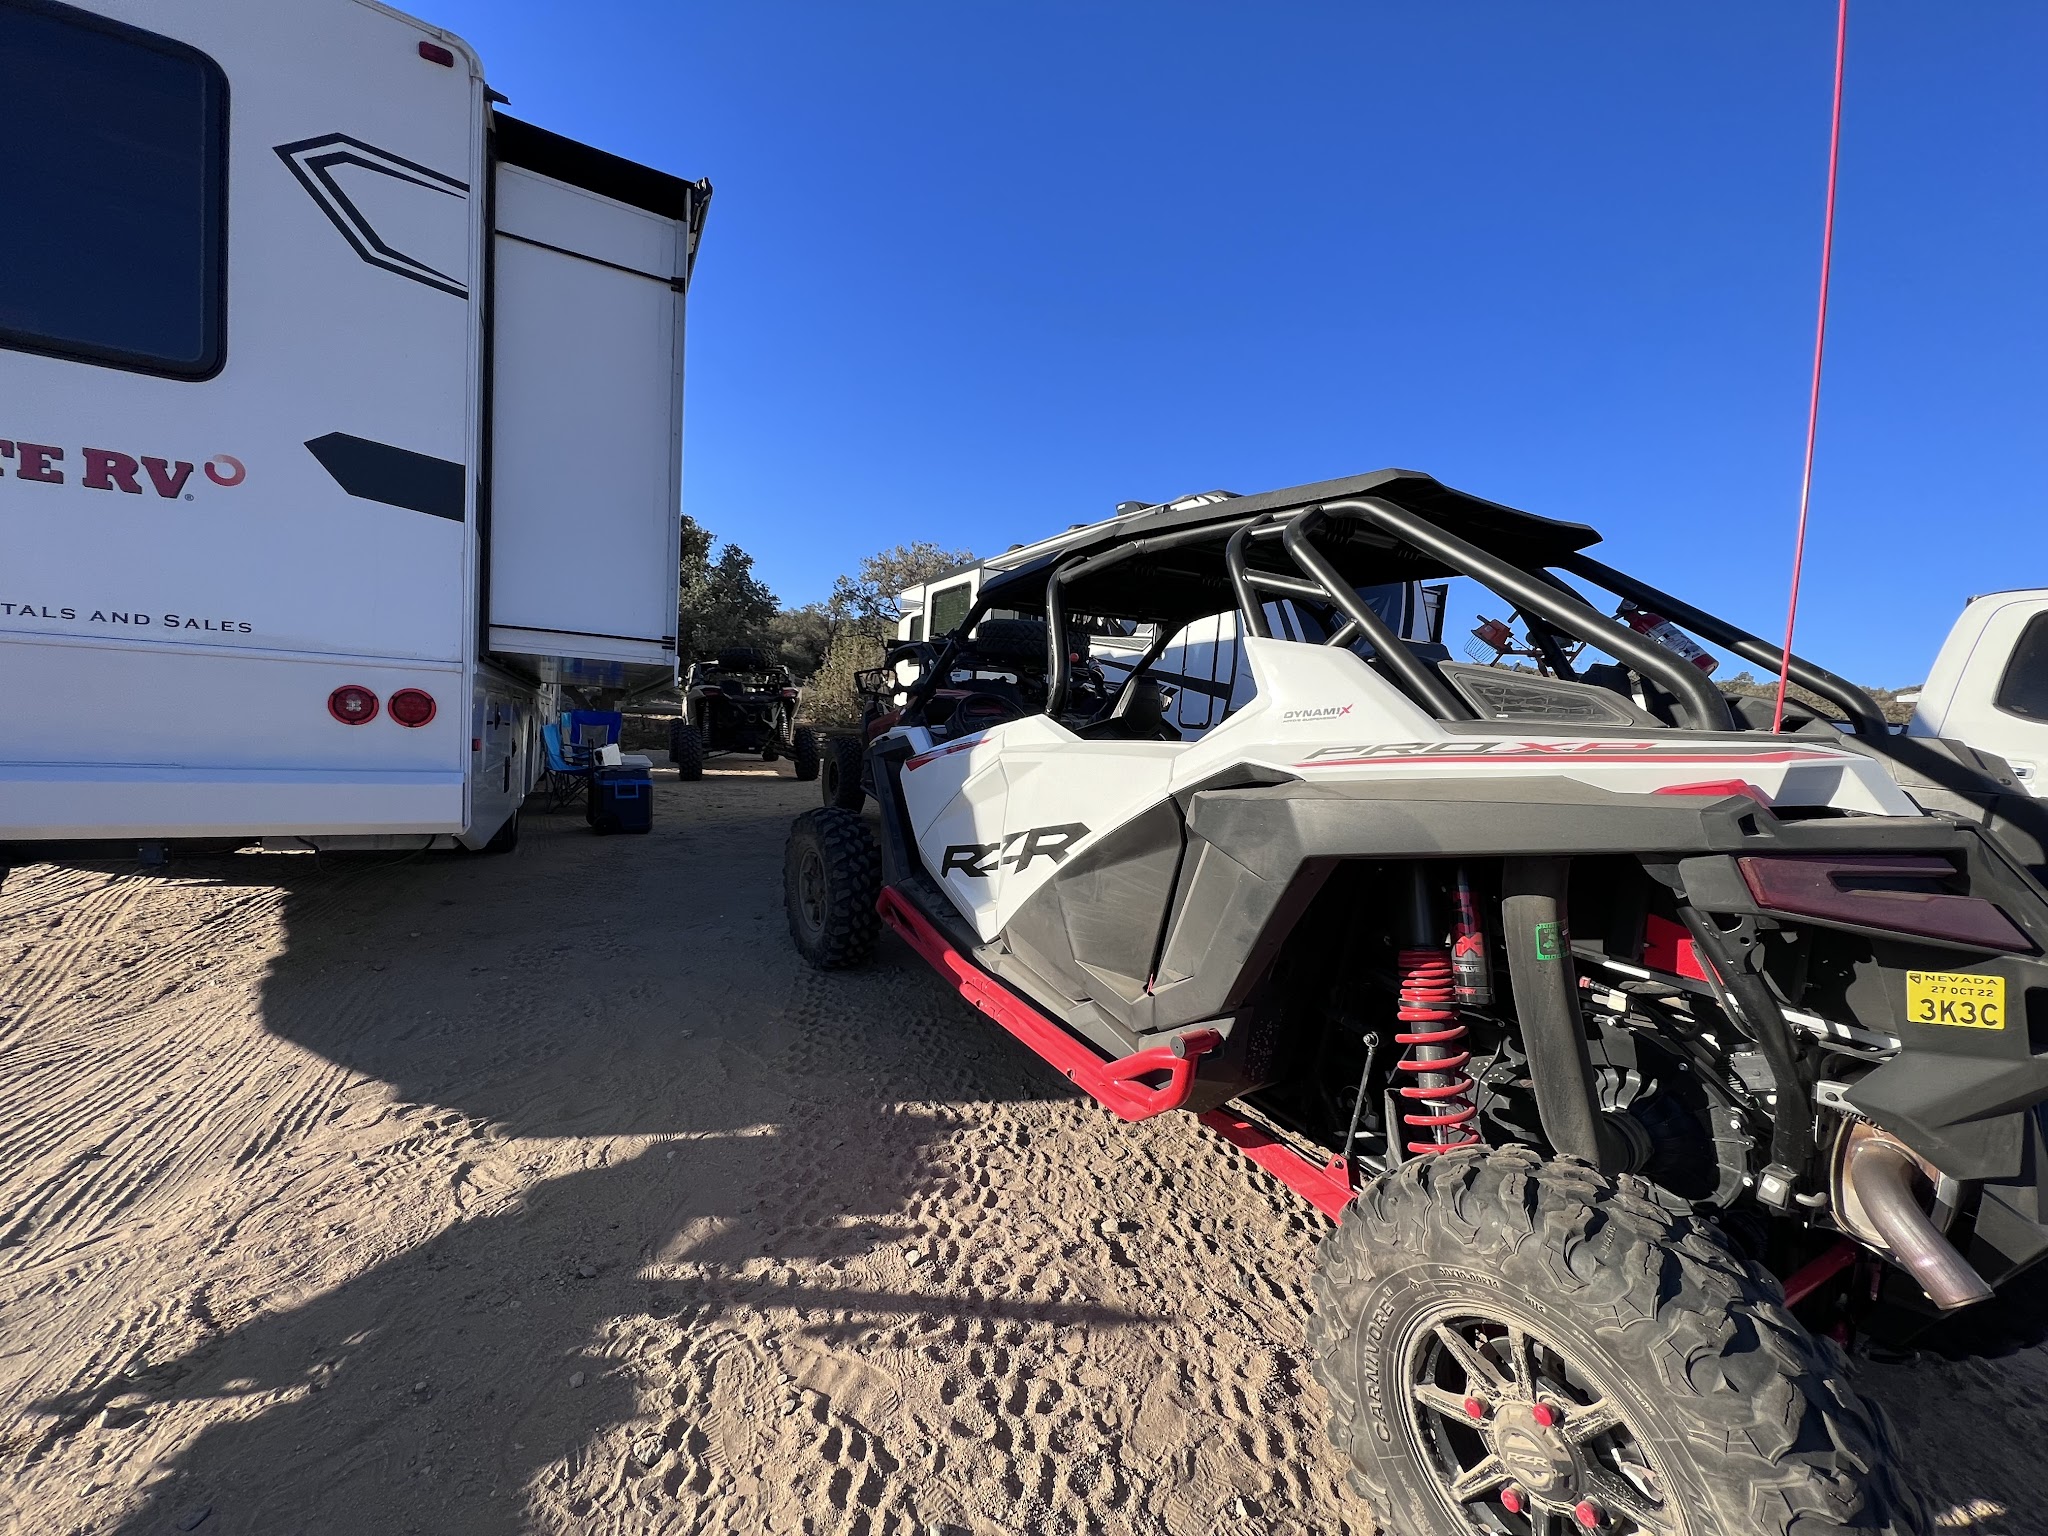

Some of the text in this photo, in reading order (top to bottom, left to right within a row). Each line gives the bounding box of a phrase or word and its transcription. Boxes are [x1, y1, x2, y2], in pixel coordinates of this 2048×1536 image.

[82, 447, 194, 499] RV
[89, 610, 151, 625] AND
[163, 614, 253, 633] SALES
[1283, 703, 1354, 719] DYNAMIX
[940, 822, 1092, 879] RZR
[1924, 974, 1999, 986] NEVADA
[1931, 985, 1995, 998] 27 OCT 22
[1919, 998, 1998, 1027] 3K3C
[1363, 1297, 1396, 1445] CARNIVORE
[1506, 1452, 1549, 1468] RZR
